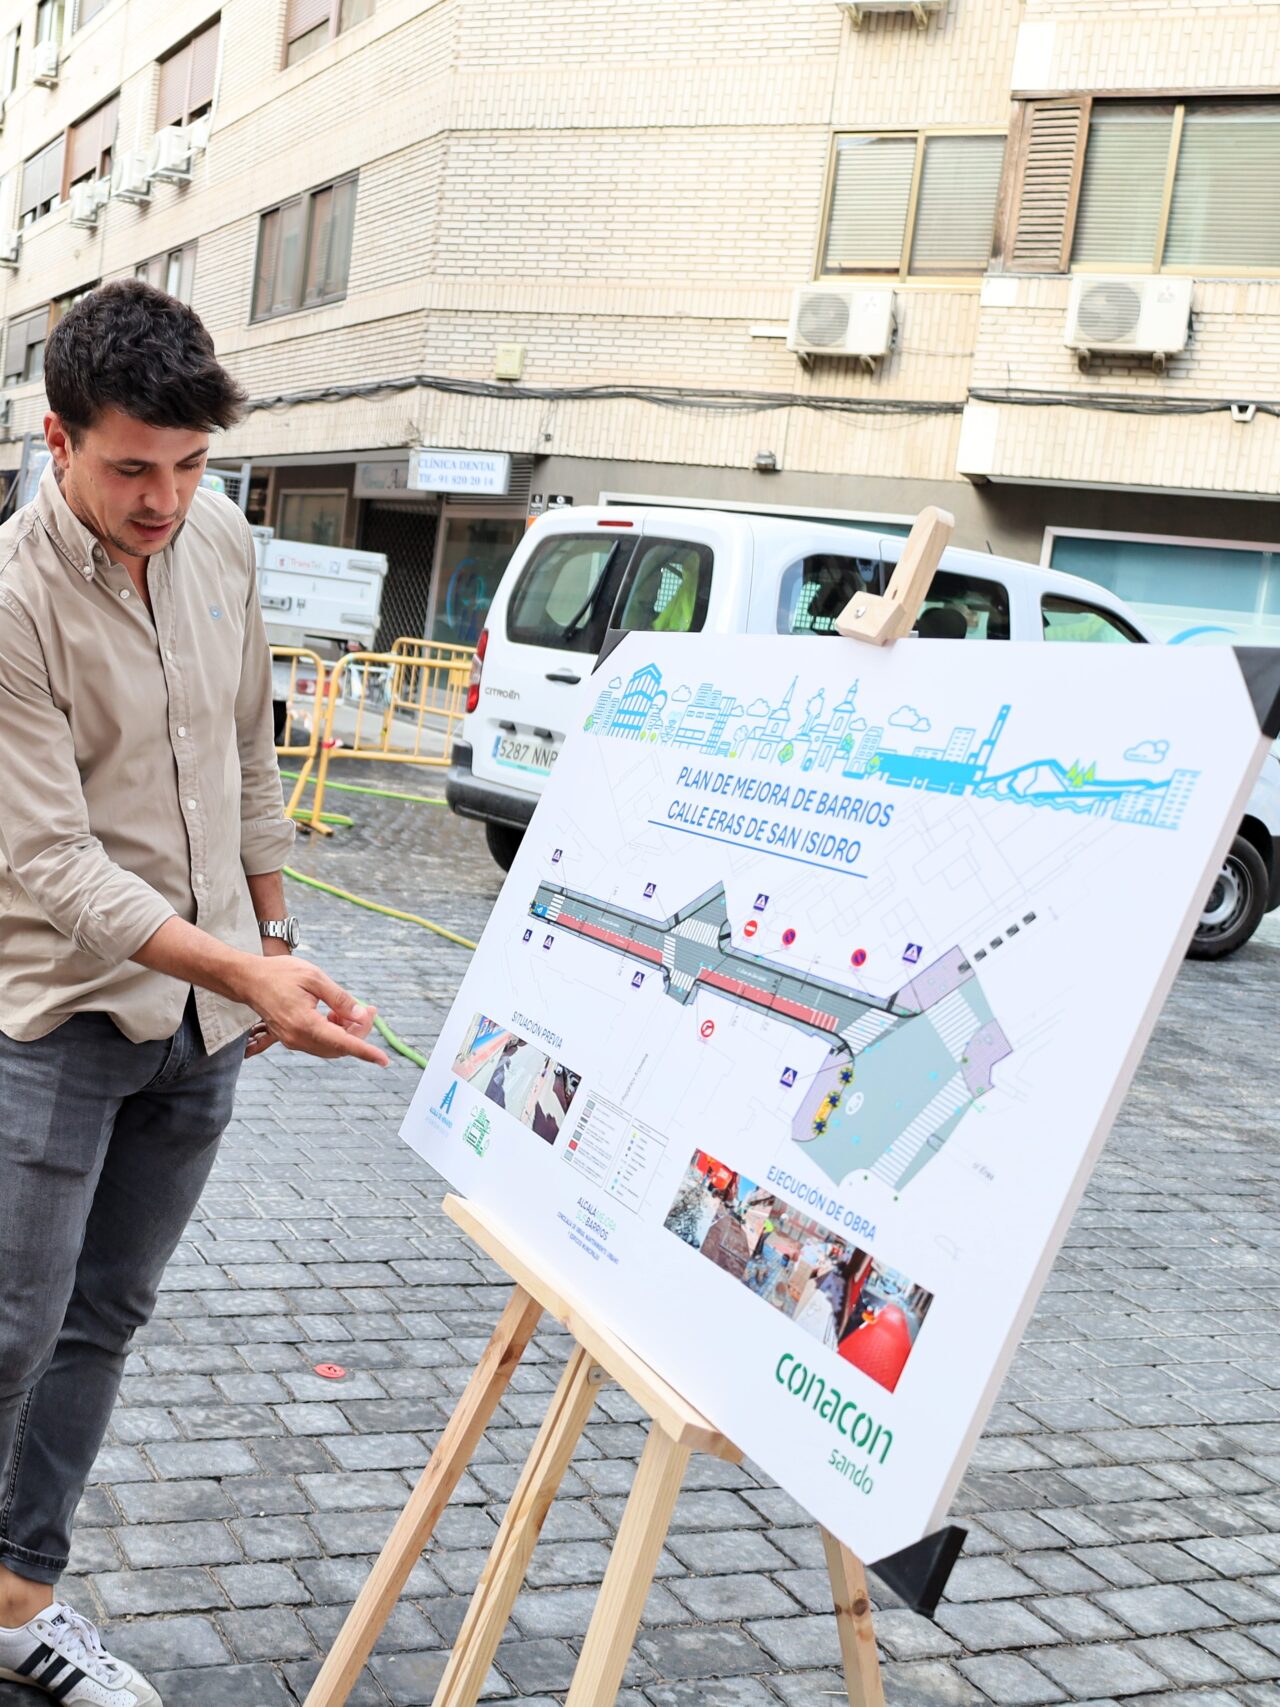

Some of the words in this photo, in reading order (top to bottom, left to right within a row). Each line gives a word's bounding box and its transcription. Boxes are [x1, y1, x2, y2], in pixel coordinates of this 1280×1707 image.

[459, 460, 496, 471] DENTAL
[499, 739, 530, 762] 5287
[531, 746, 559, 768] NNP
[676, 766, 714, 791] PLAN
[711, 772, 734, 795] DE
[731, 776, 790, 807] MEJORA
[791, 787, 817, 812] DE
[815, 792, 895, 828] BARRIOS
[667, 800, 709, 827] CALLE
[707, 809, 745, 836] ERAS
[744, 817, 767, 842] DE
[766, 822, 803, 850] SAN
[800, 831, 862, 864] ISIDRO
[511, 1010, 542, 1037] SITUACIÓN
[541, 1028, 563, 1050] PREVIA
[766, 1165, 825, 1211] EJECUCIÓN
[825, 1200, 845, 1221] DE
[844, 1211, 877, 1241] OBRA
[775, 1353, 893, 1465] conacon
[828, 1449, 874, 1495] sando
